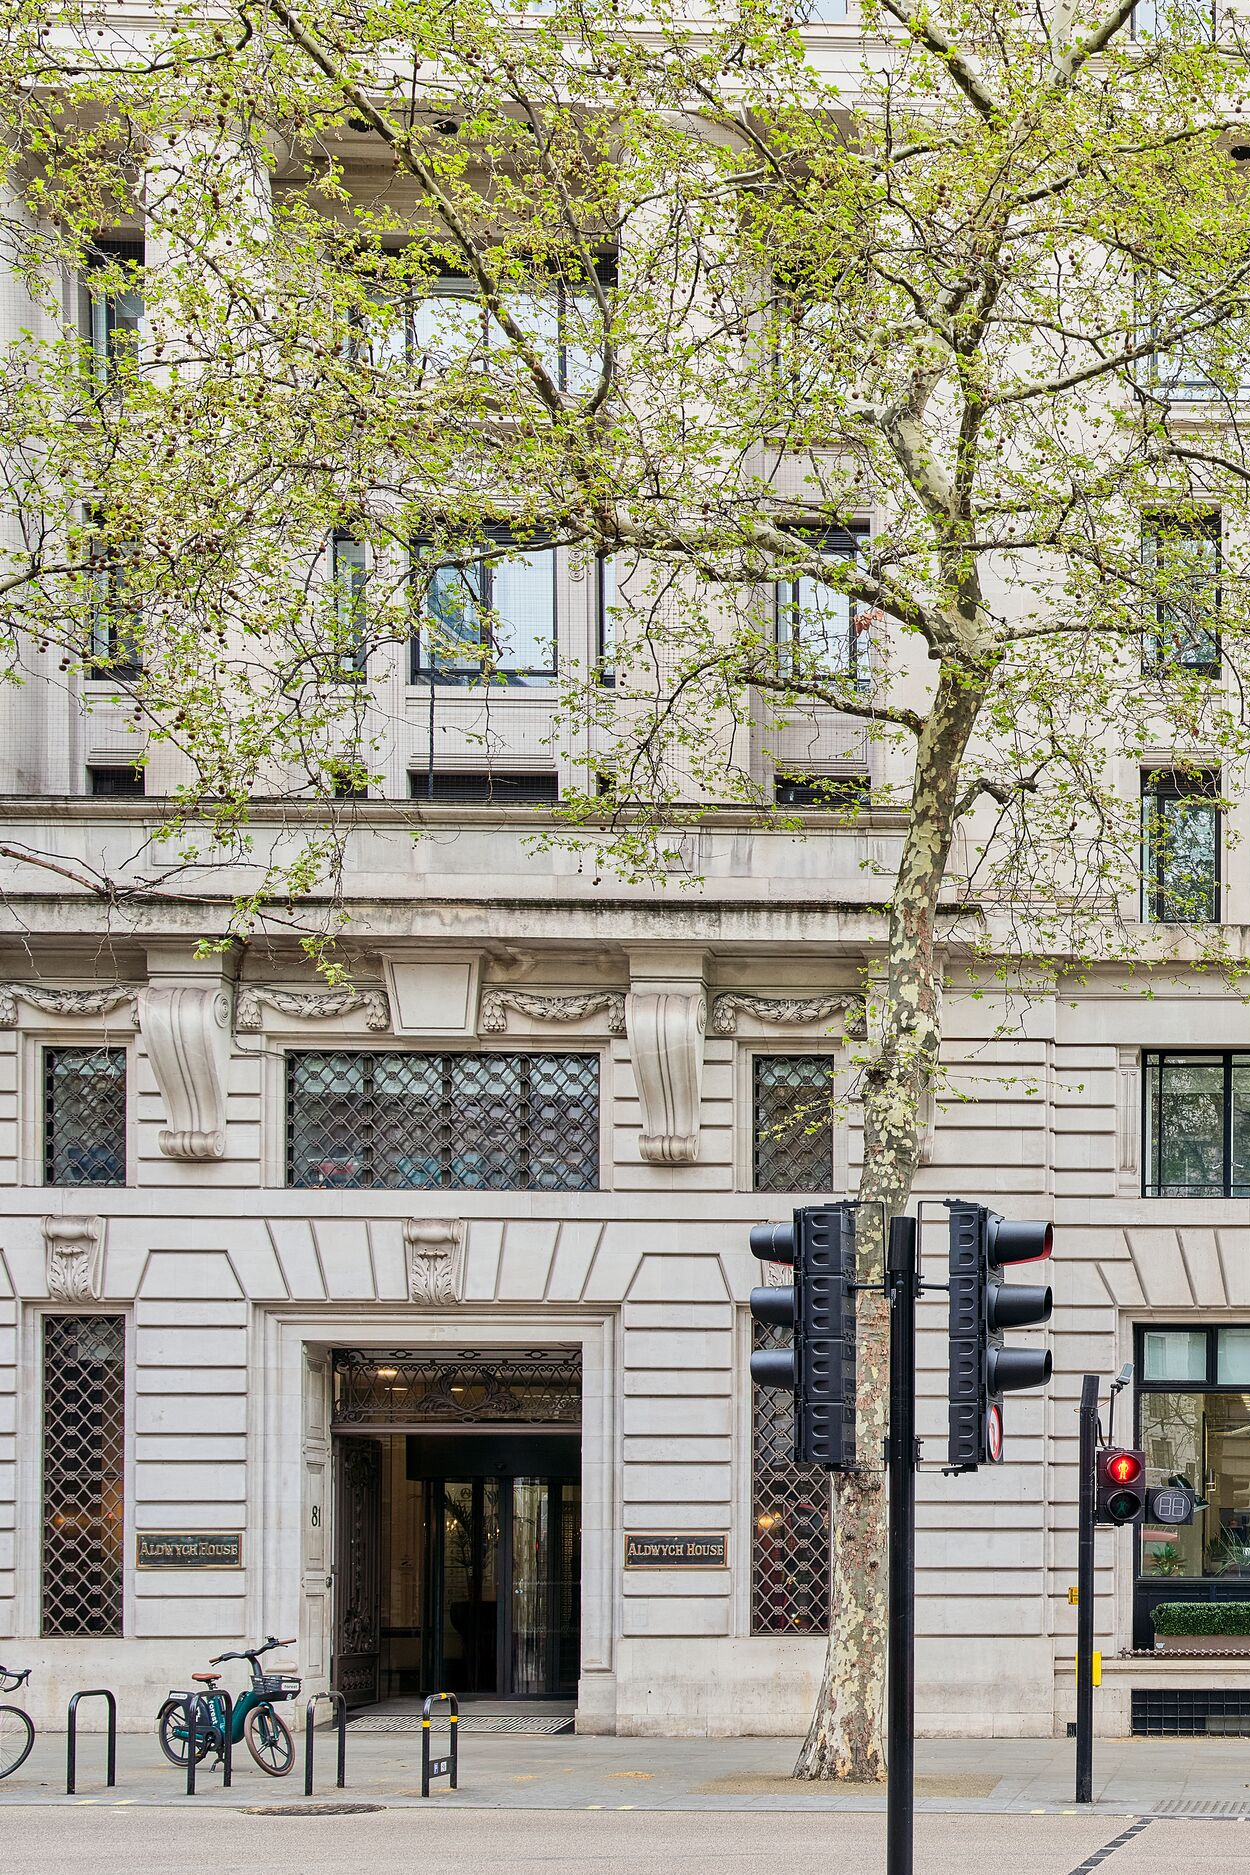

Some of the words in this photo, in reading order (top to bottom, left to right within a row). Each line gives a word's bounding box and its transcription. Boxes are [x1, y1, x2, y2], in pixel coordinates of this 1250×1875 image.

[311, 1505, 321, 1527] 81
[140, 1542, 198, 1556] ALDWYCH
[199, 1542, 238, 1556] HOUSE
[628, 1542, 684, 1556] ALDWYCH
[686, 1542, 724, 1556] HOUSE
[208, 1700, 218, 1725] forest
